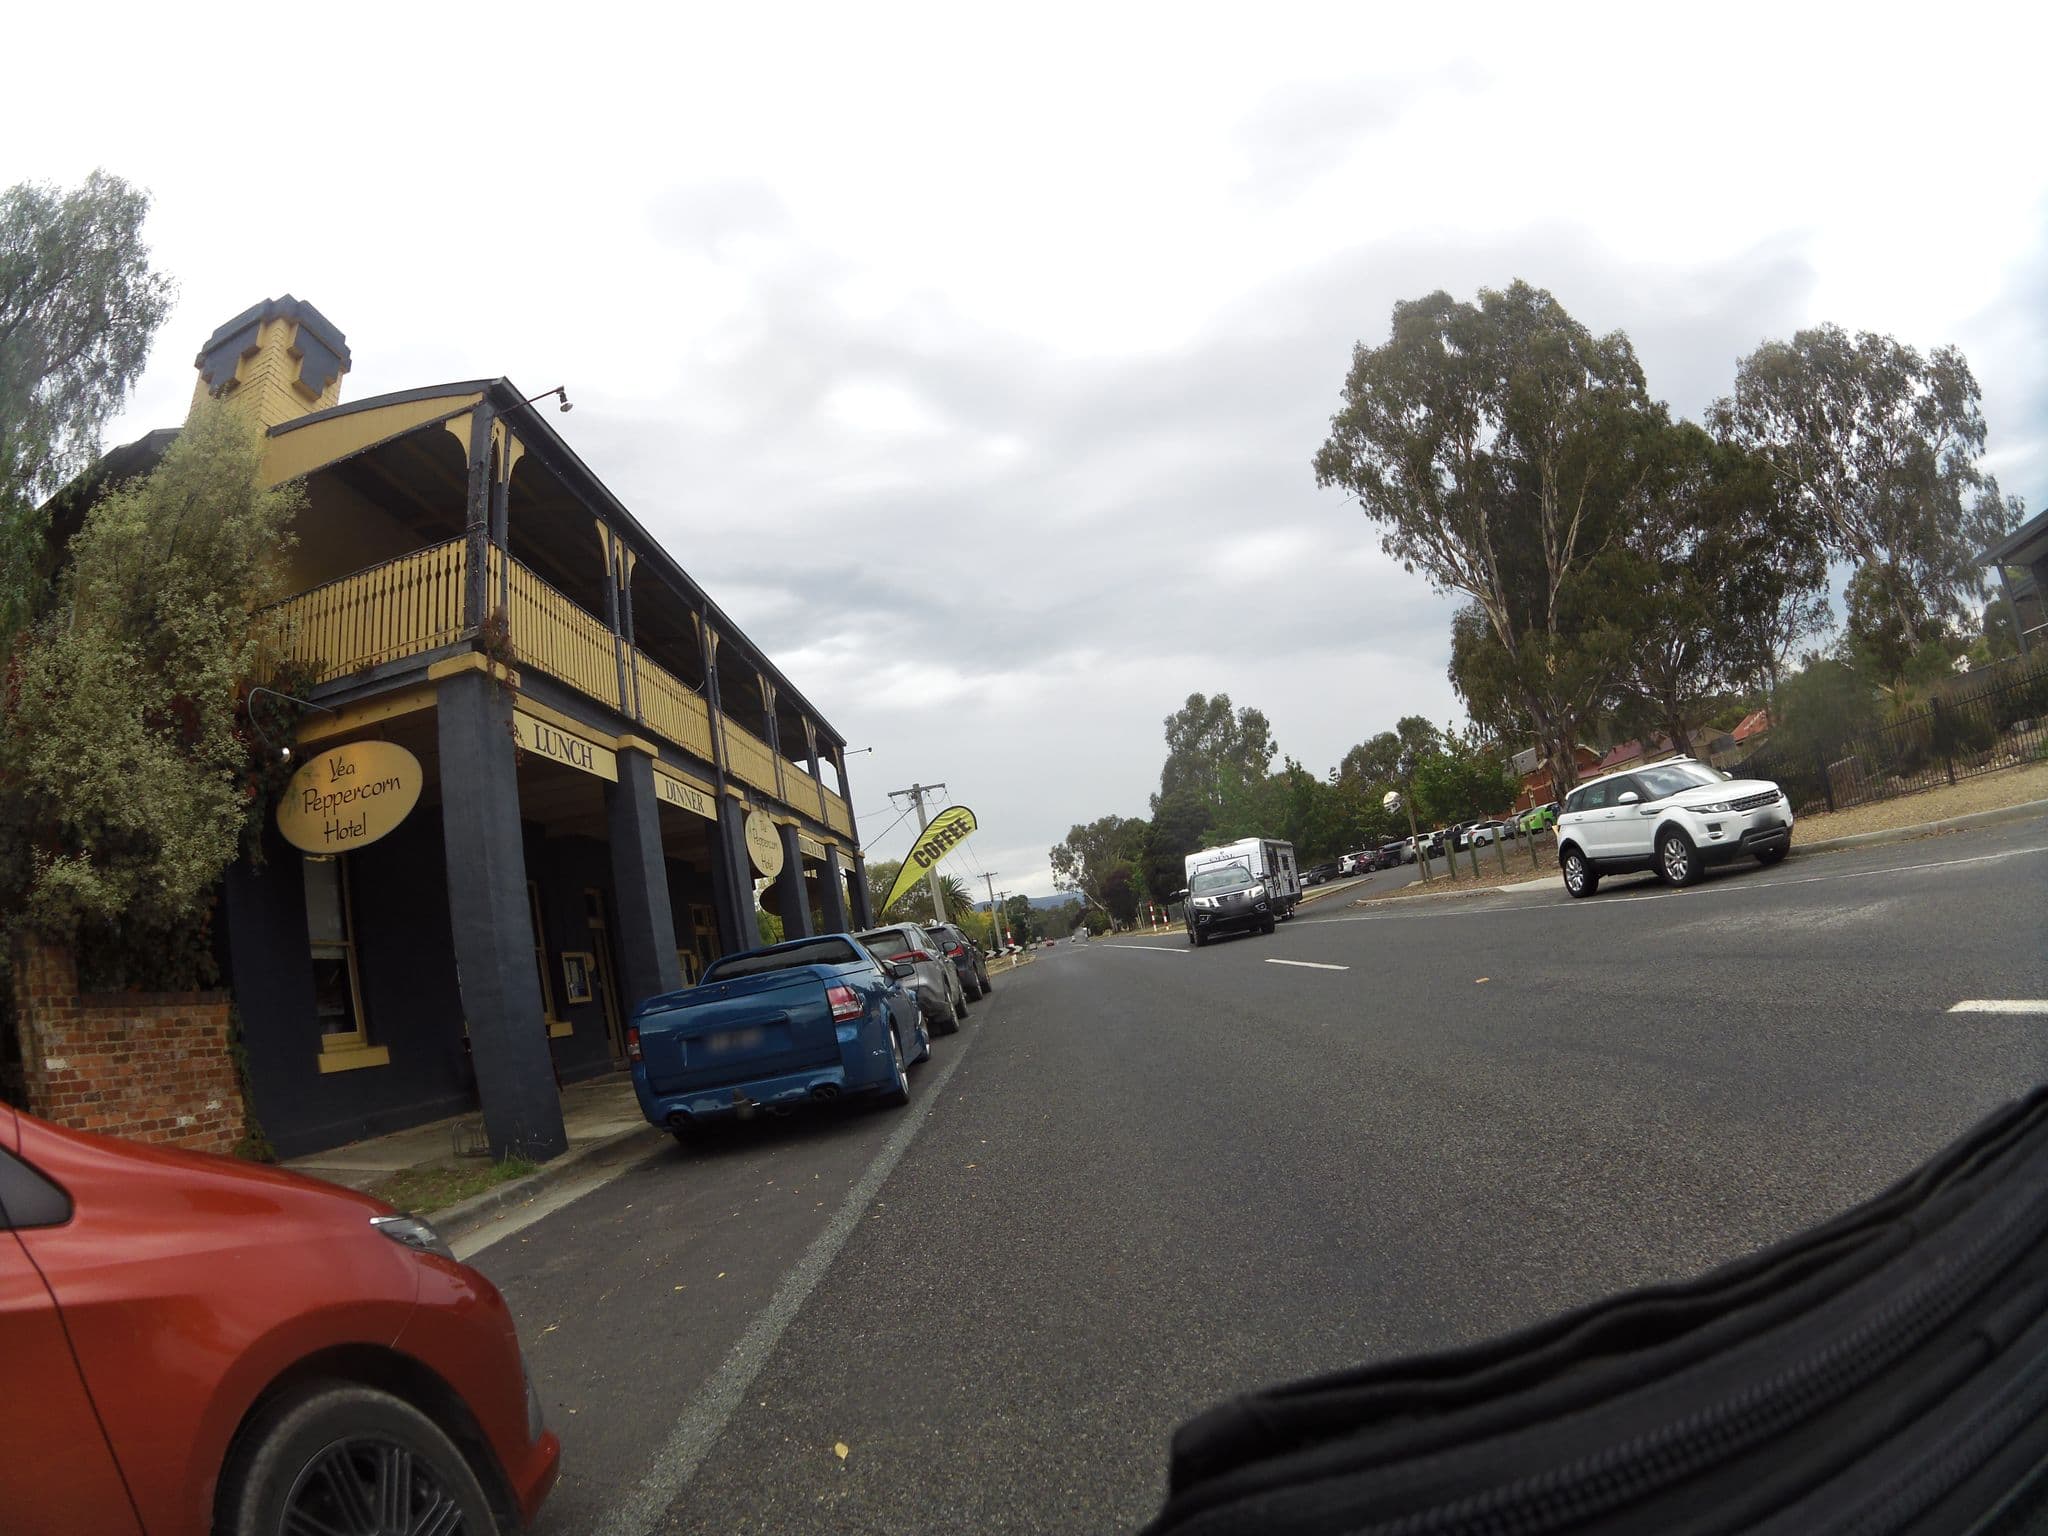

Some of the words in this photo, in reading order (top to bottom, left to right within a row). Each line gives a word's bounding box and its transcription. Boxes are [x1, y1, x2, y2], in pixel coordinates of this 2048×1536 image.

[533, 723, 594, 770] LUNCH
[328, 756, 355, 783] Yea
[302, 777, 401, 818] Peppercorn
[664, 779, 705, 814] DINNER
[324, 812, 367, 844] Hotel
[912, 817, 972, 869] COFFEE
